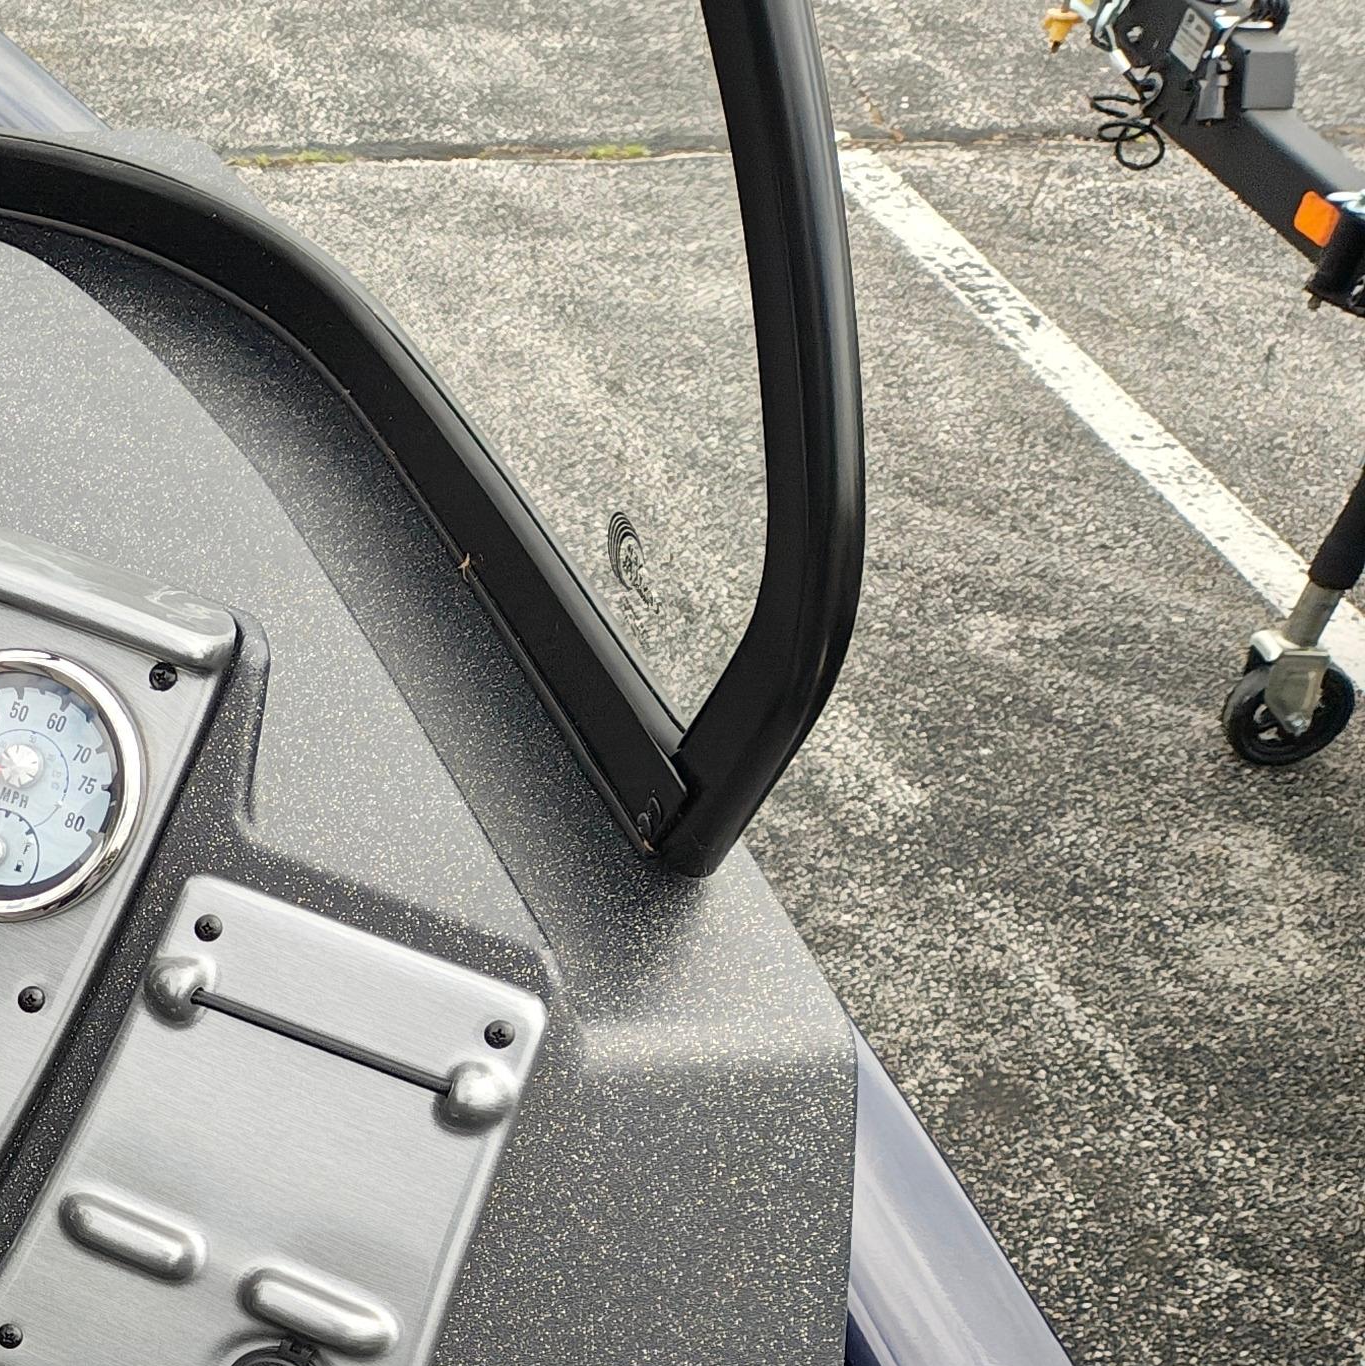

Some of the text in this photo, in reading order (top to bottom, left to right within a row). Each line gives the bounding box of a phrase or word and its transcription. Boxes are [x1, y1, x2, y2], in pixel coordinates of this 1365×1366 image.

[9, 701, 29, 722] 50
[47, 712, 67, 733] 60
[72, 744, 92, 764] 70
[77, 775, 97, 795] 75
[0, 786, 29, 809] MPH
[64, 812, 85, 832] 80
